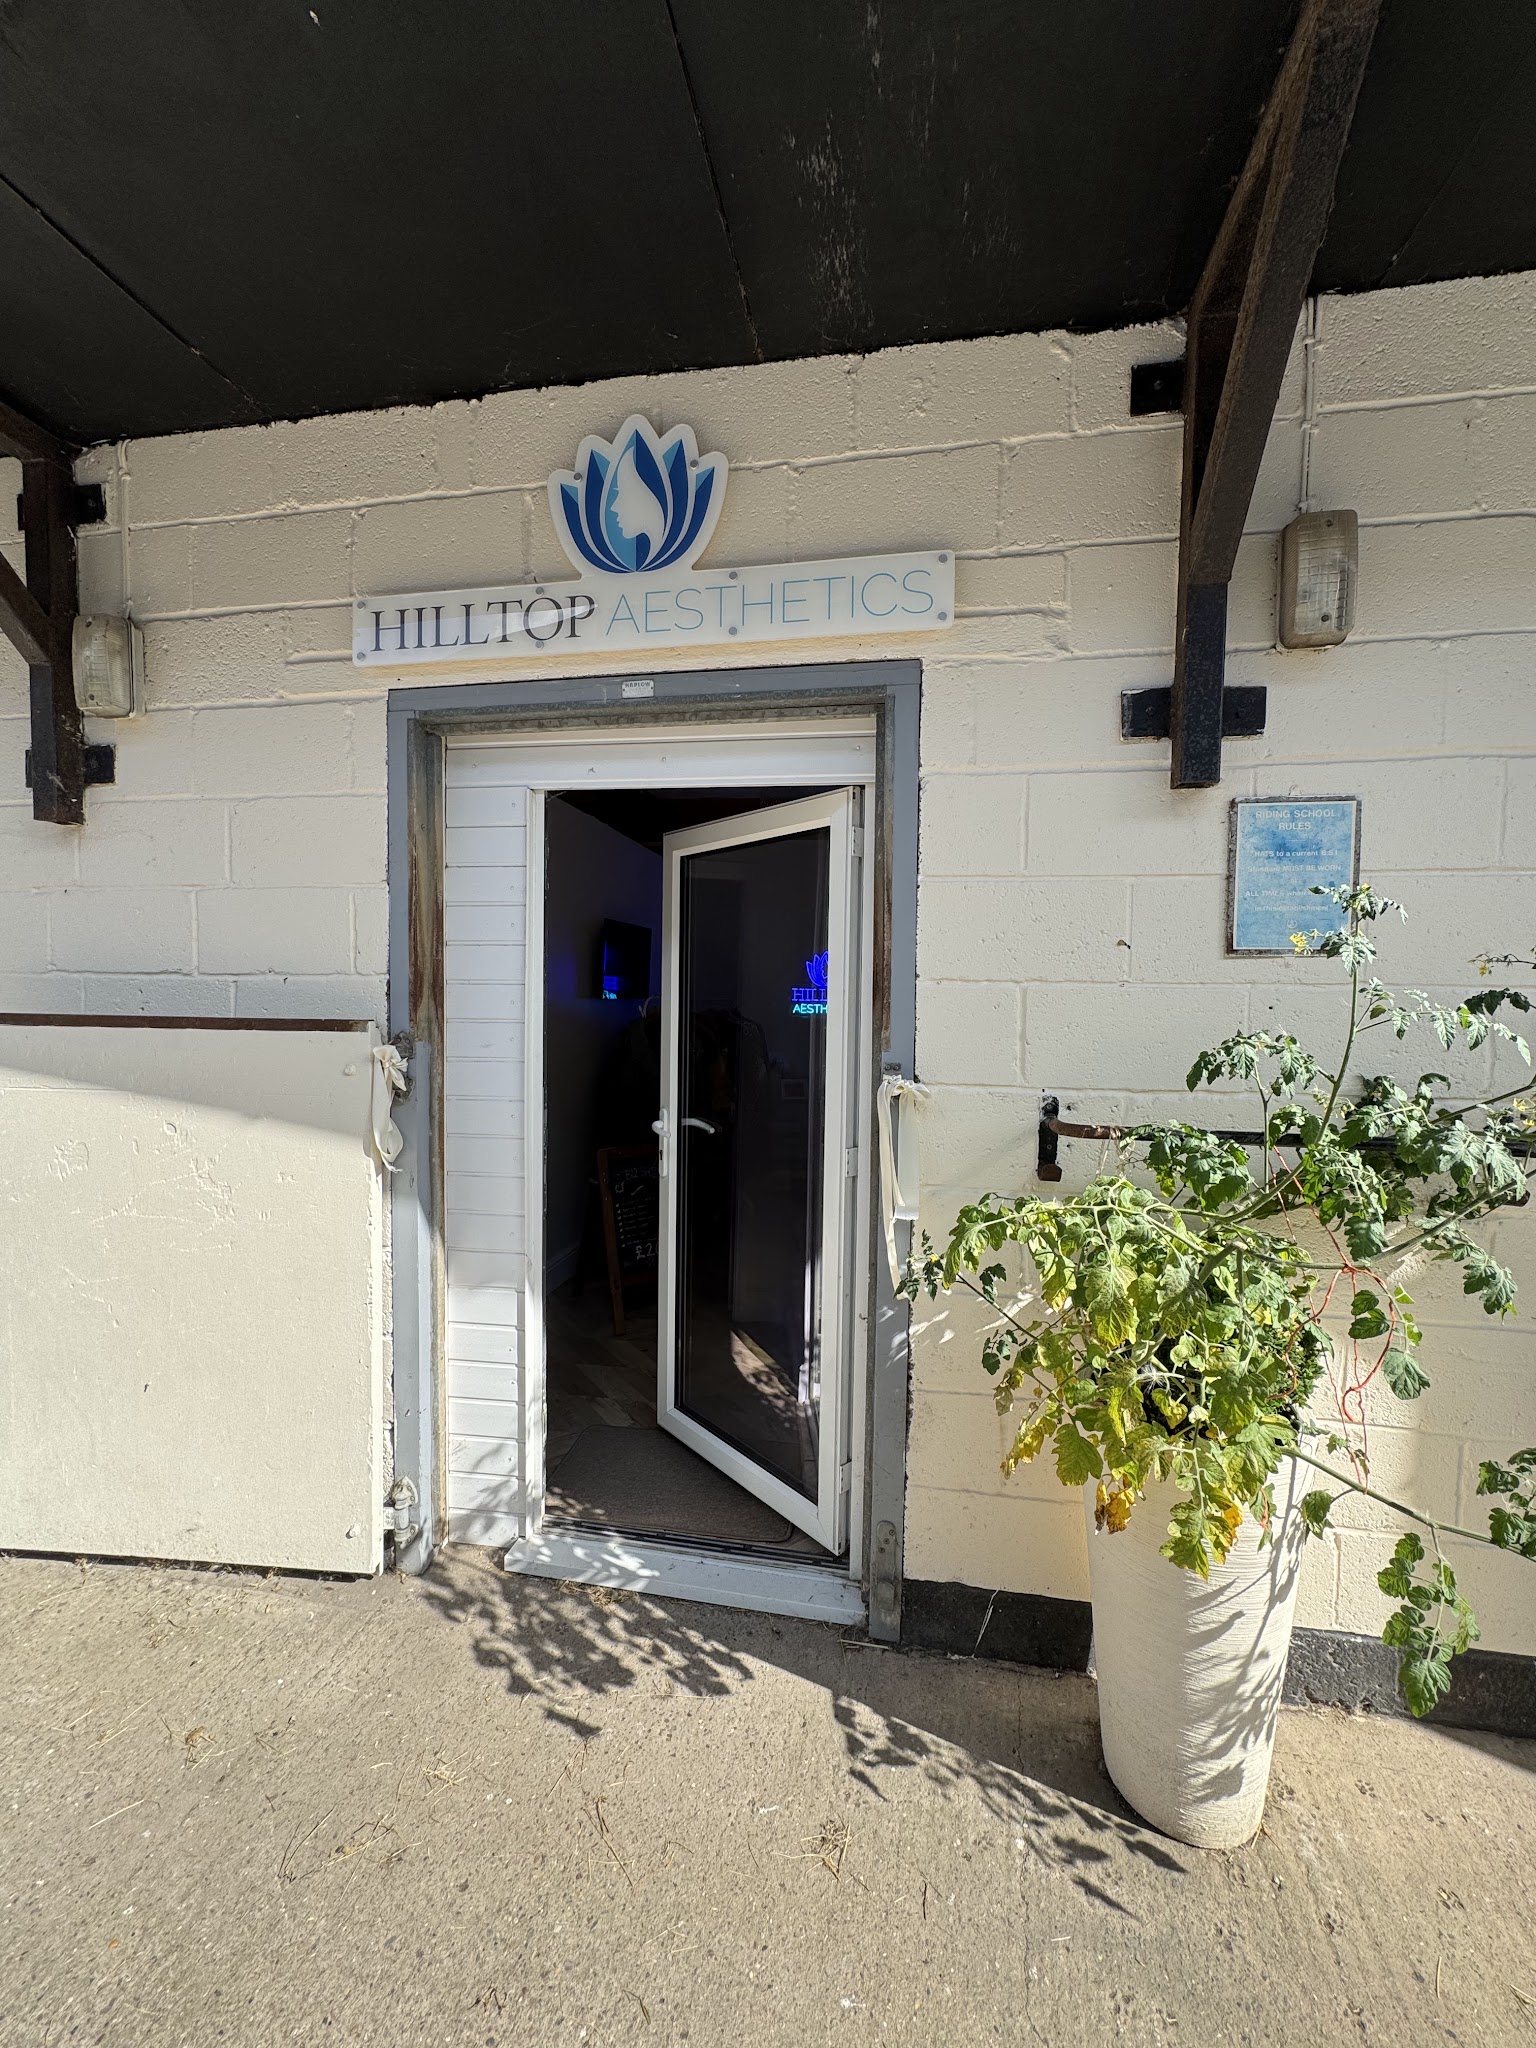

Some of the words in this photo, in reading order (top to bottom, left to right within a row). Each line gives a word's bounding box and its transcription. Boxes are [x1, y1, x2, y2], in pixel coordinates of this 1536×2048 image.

[370, 595, 596, 652] HILLTOP
[606, 570, 935, 636] AESTHETICS
[1255, 810, 1290, 819] RIDING
[1294, 809, 1336, 818] SCHOOL
[1278, 822, 1311, 831] RULES
[792, 1003, 828, 1014] AESTH
